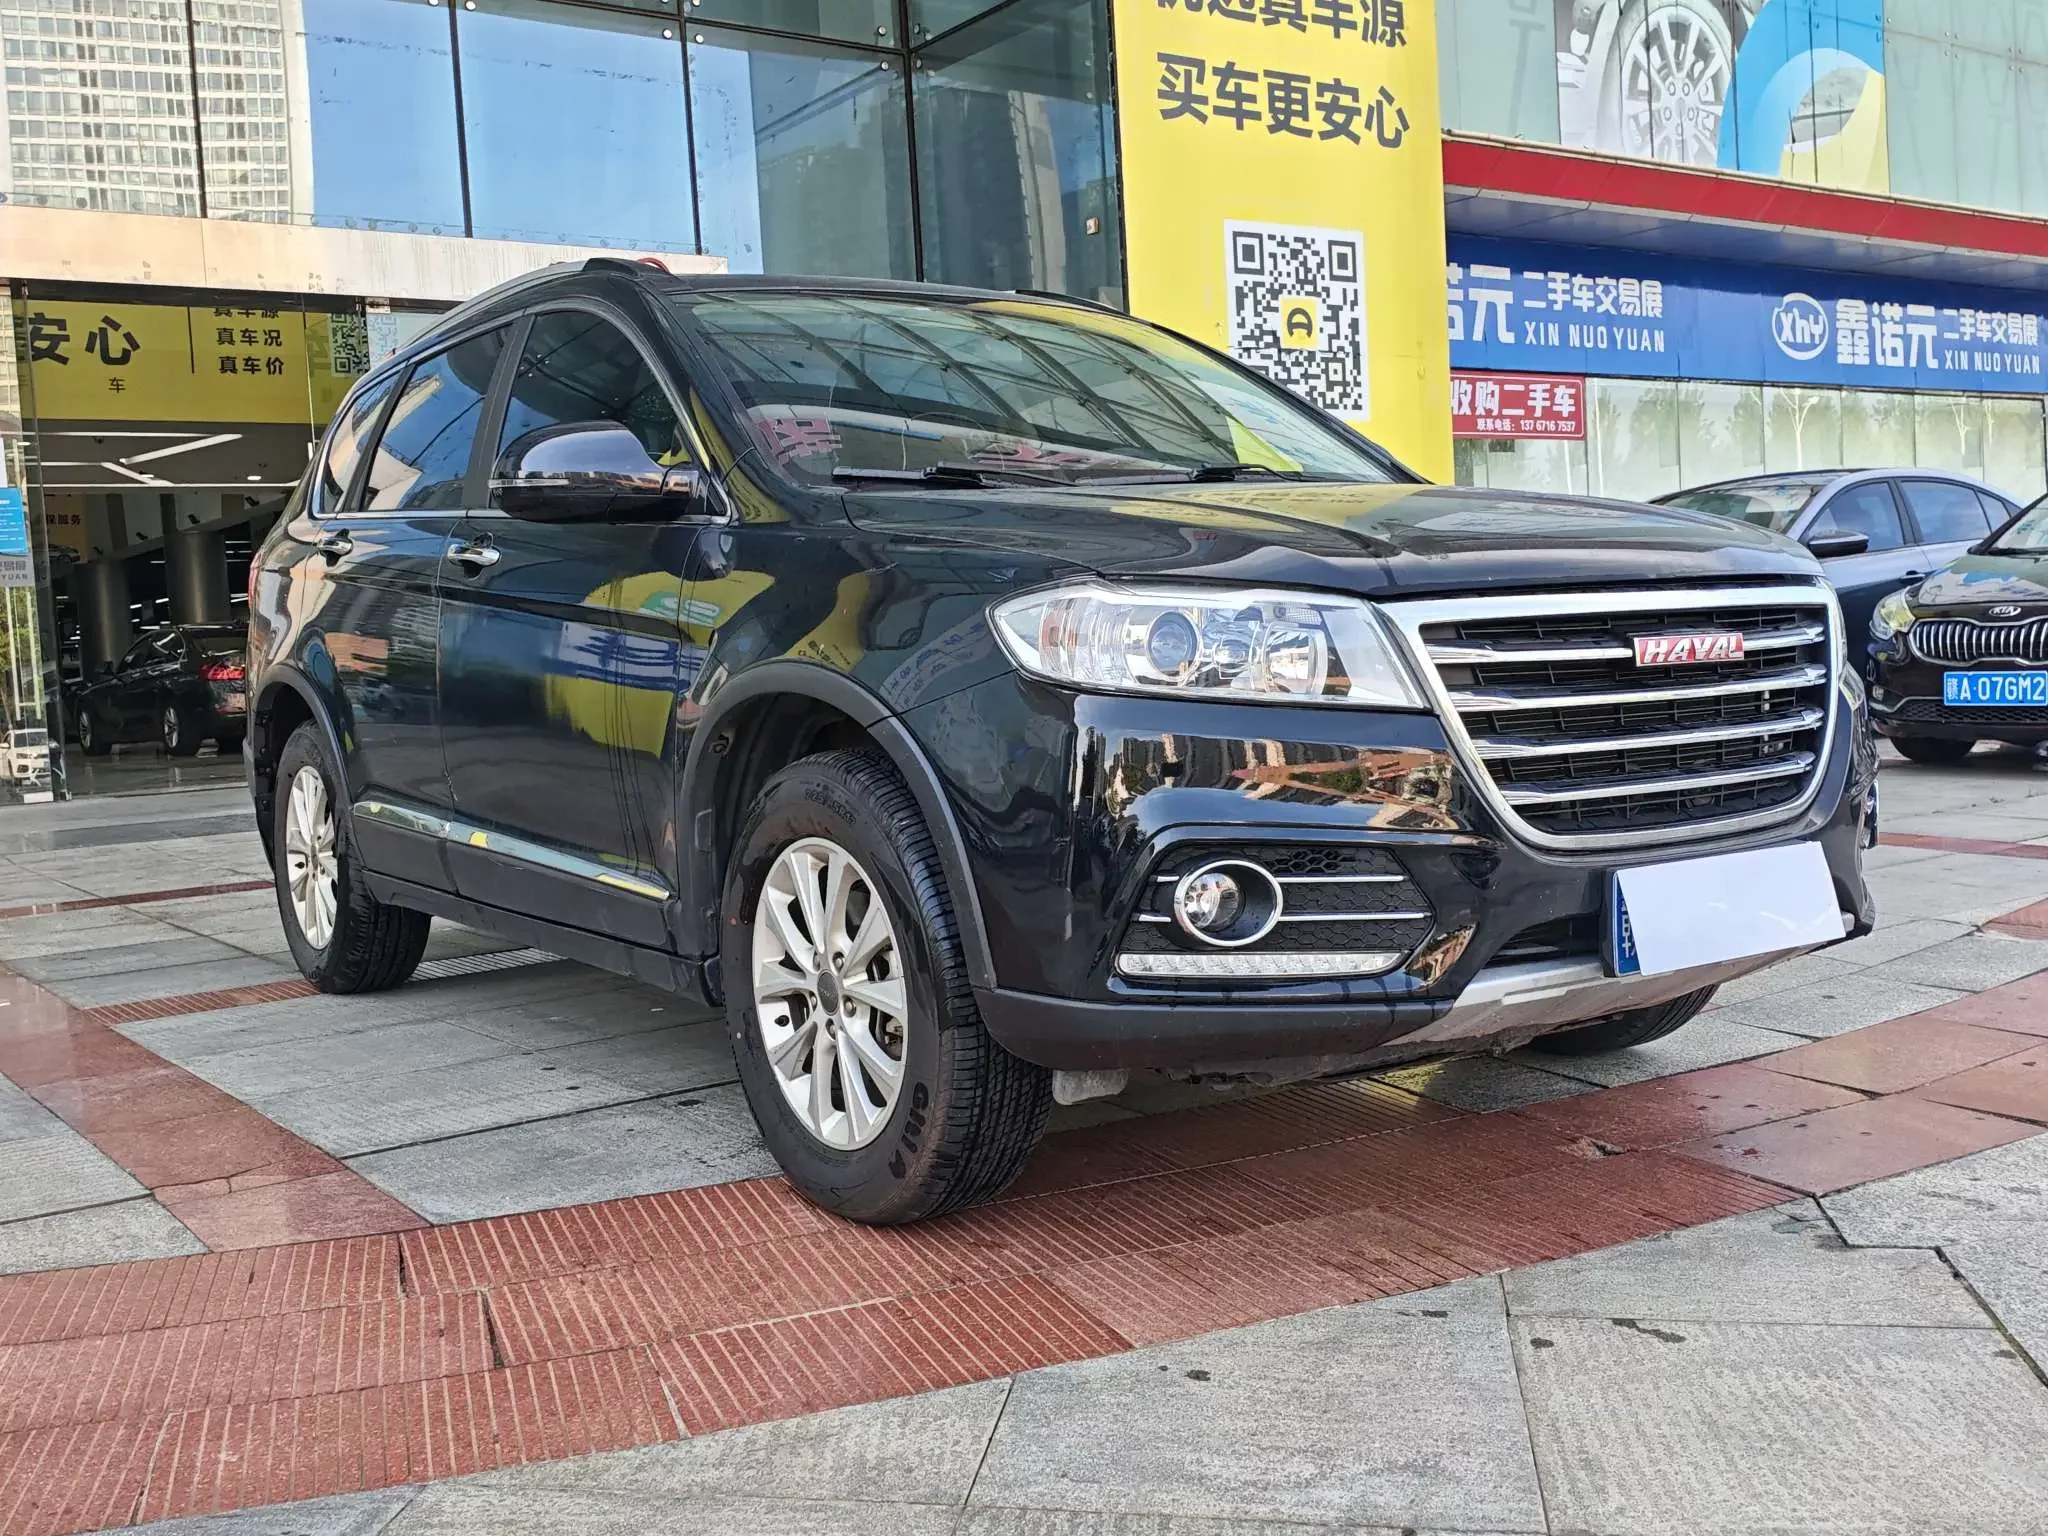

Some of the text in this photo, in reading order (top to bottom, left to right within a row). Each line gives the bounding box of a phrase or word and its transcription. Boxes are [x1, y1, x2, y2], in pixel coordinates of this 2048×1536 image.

[1157, 52, 1410, 149] 买车更安心
[1523, 271, 1663, 318] 二手车交易展
[216, 328, 282, 347] 真车况
[1525, 321, 1665, 352] XIN NUO YUAN
[1836, 298, 2039, 369] 鑫诺元 二手车交易展
[219, 356, 284, 375] 真车价
[1944, 349, 2040, 375] XIN NUO YUAN
[1643, 635, 1743, 663] HAVAL
